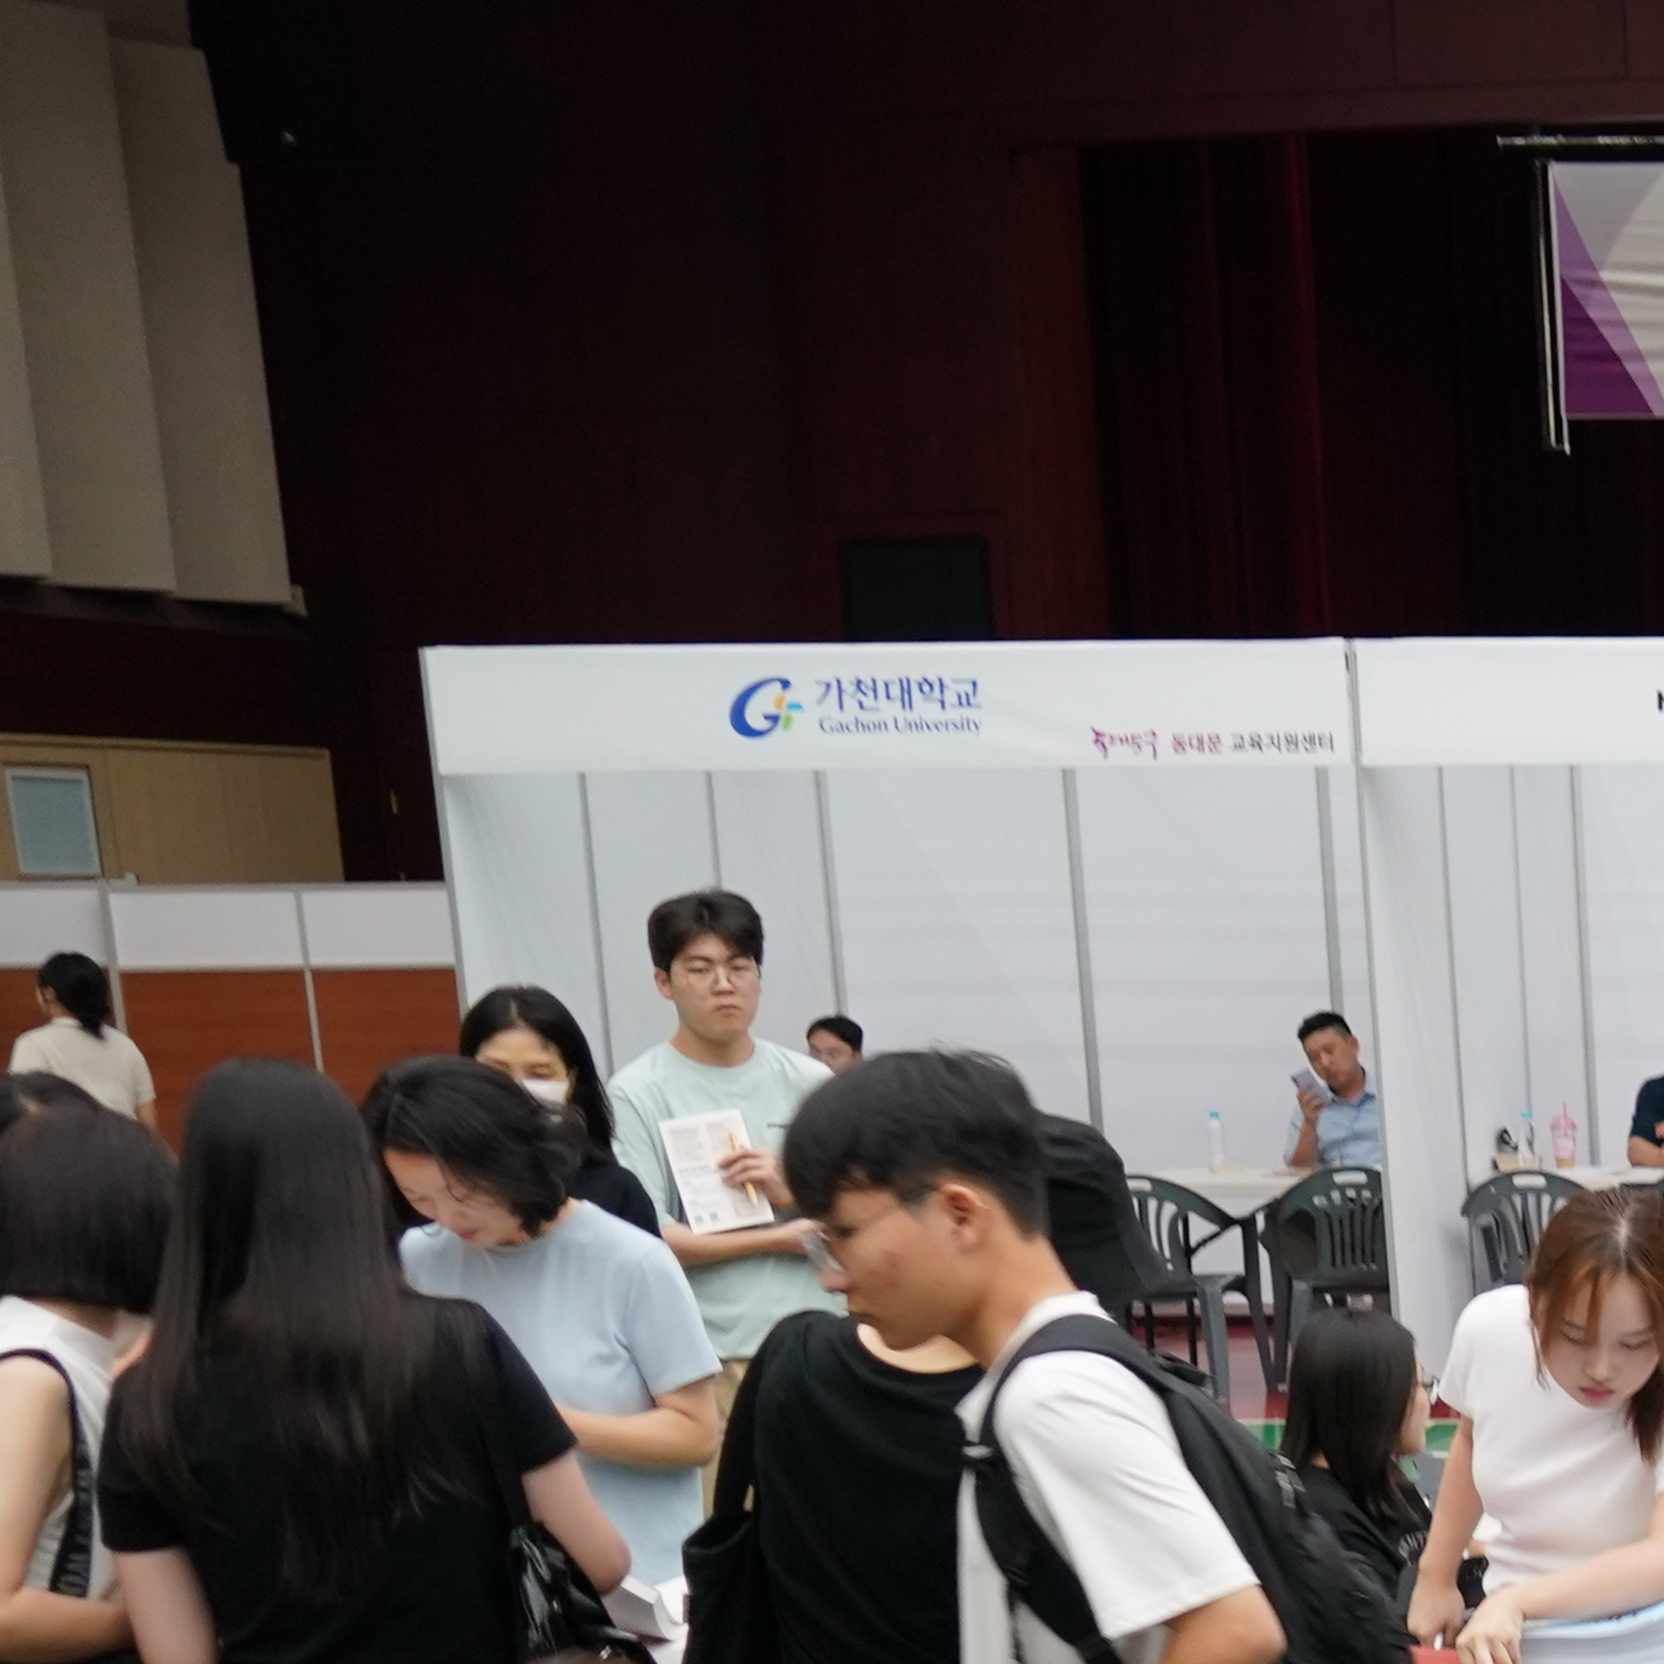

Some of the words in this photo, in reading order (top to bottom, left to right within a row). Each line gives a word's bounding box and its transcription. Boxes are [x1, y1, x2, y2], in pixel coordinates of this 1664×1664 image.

[814, 676, 981, 711] 가천대학교
[818, 712, 890, 735] Gachon
[892, 712, 981, 736] University
[1233, 732, 1335, 753] 교육지원센터
